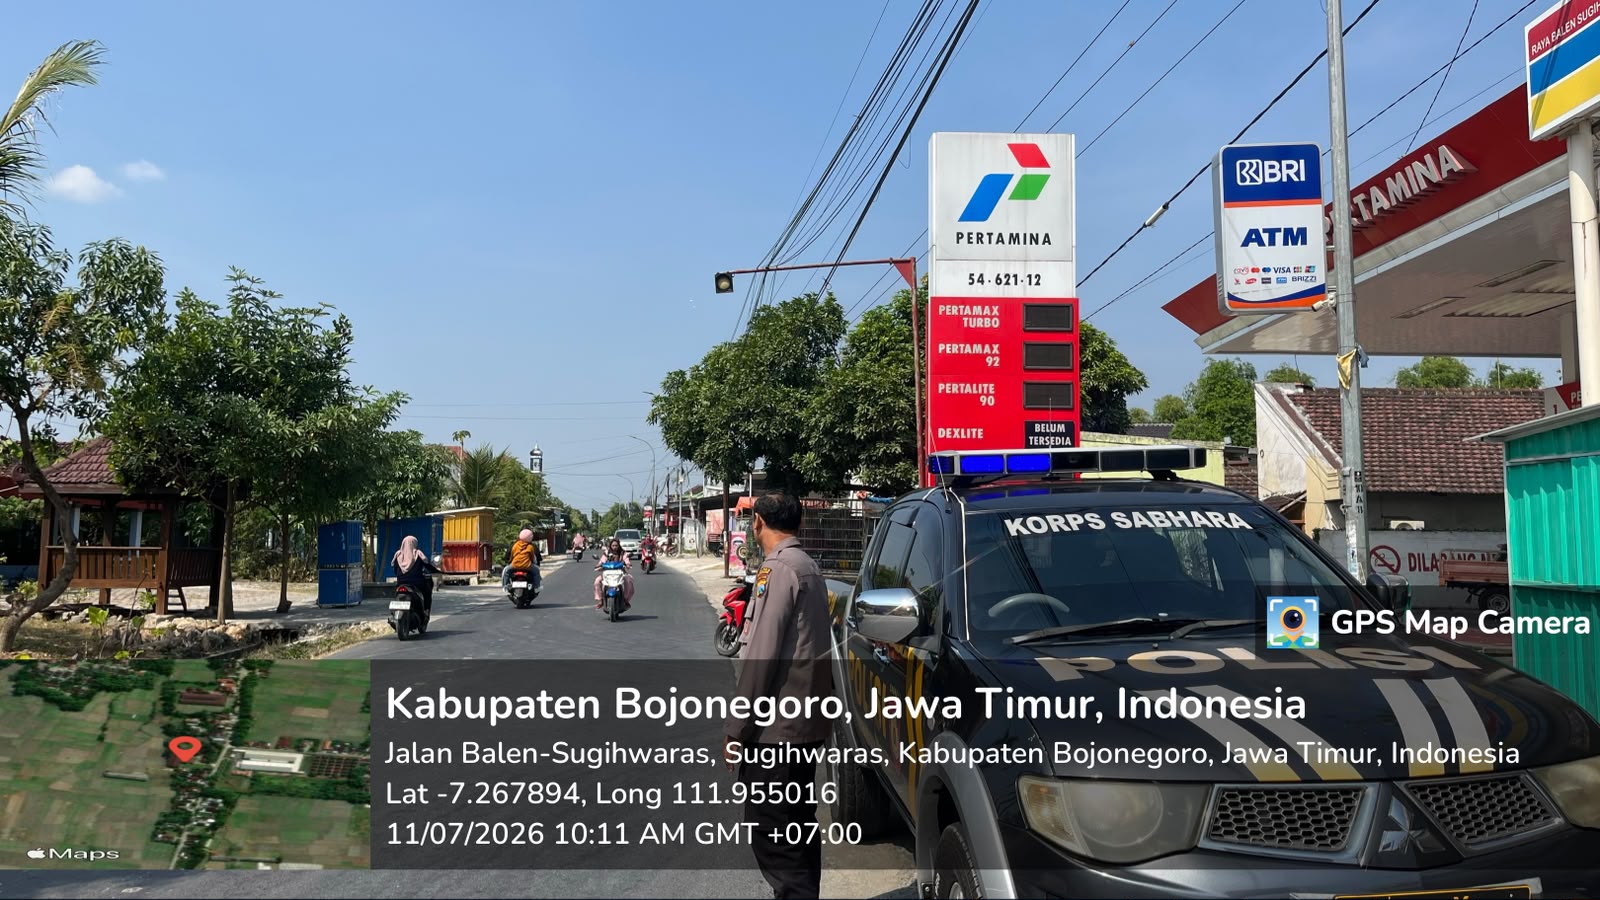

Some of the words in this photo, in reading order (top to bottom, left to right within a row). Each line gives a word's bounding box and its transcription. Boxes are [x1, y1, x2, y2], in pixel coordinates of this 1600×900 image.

[1531, 36, 1551, 55] RAYA
[1551, 18, 1576, 43] BALEN
[1264, 159, 1306, 183] BRI
[956, 232, 1052, 246] PERTAMINA
[1240, 227, 1307, 248] ATM
[1273, 266, 1291, 274] VISA
[939, 305, 999, 316] PERTAMAX
[963, 317, 1000, 328] TURBO
[938, 343, 1000, 354] PERTAMAX
[985, 356, 1000, 367] 92
[938, 383, 995, 394] PERTALITE
[980, 395, 995, 406] 90
[938, 428, 984, 439] DEXLITE
[1034, 423, 1066, 433] BELUM
[1029, 436, 1072, 446] TERSEDIA
[1004, 513, 1106, 537] KORPS
[1110, 511, 1253, 530] SABHARA
[1034, 646, 1482, 682] POLISI
